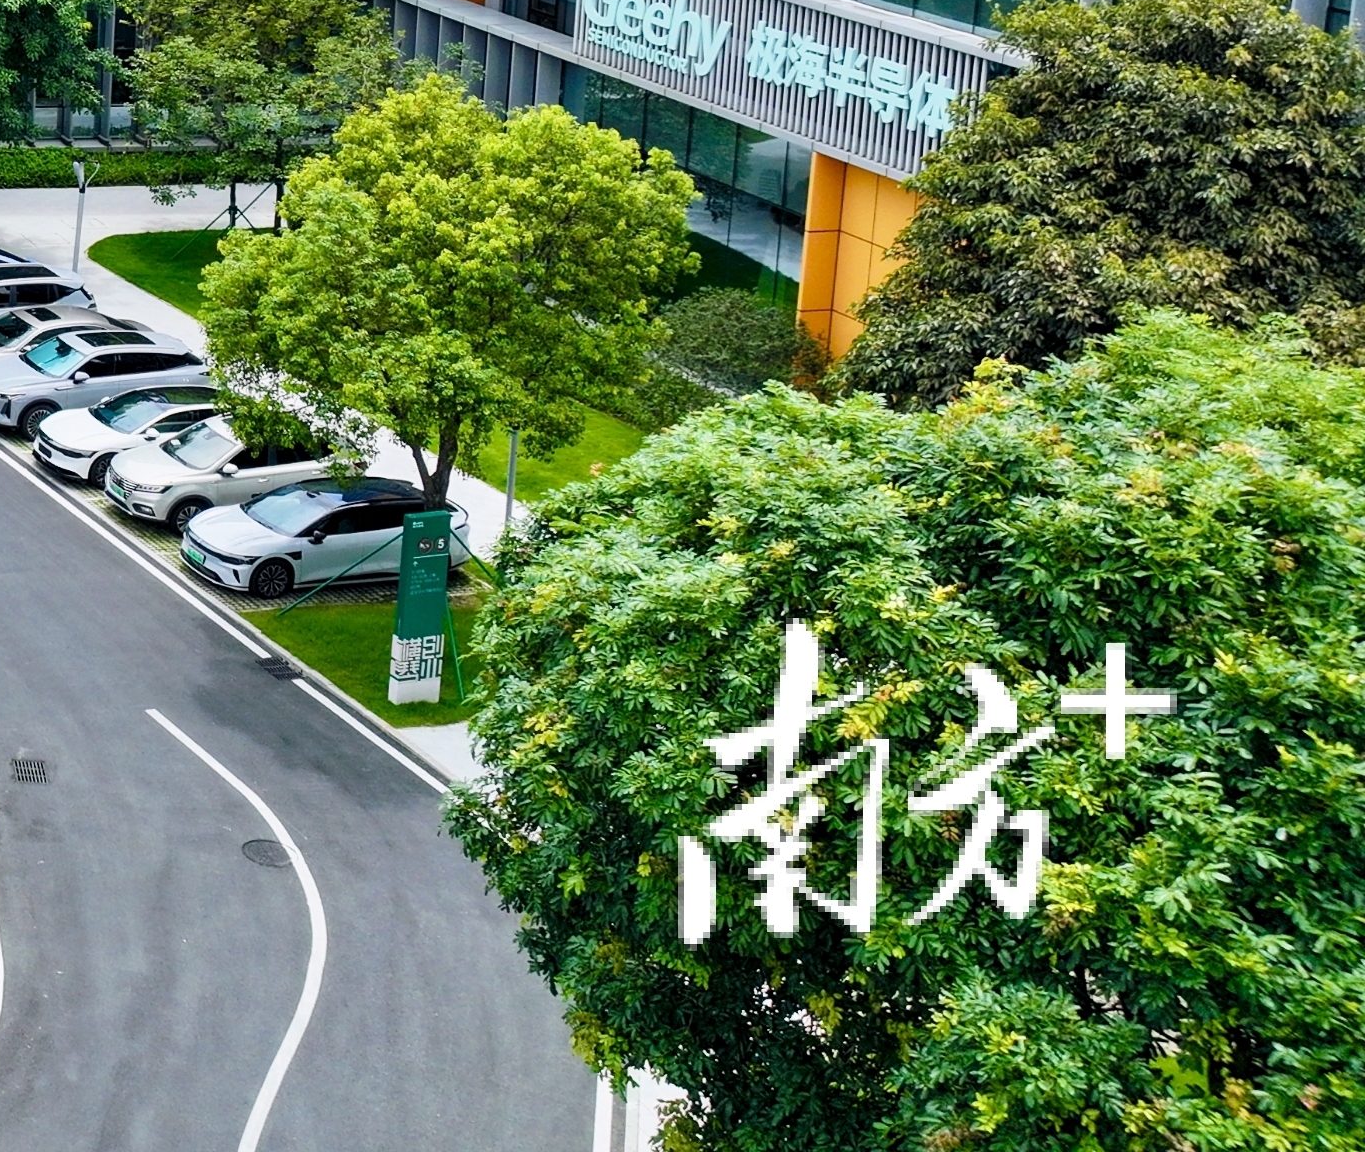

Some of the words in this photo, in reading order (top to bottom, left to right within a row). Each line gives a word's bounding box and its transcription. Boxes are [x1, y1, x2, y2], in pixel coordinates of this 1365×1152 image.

[587, 27, 689, 75] SEMICONDUCTOR
[745, 19, 959, 139] 极海半导体
